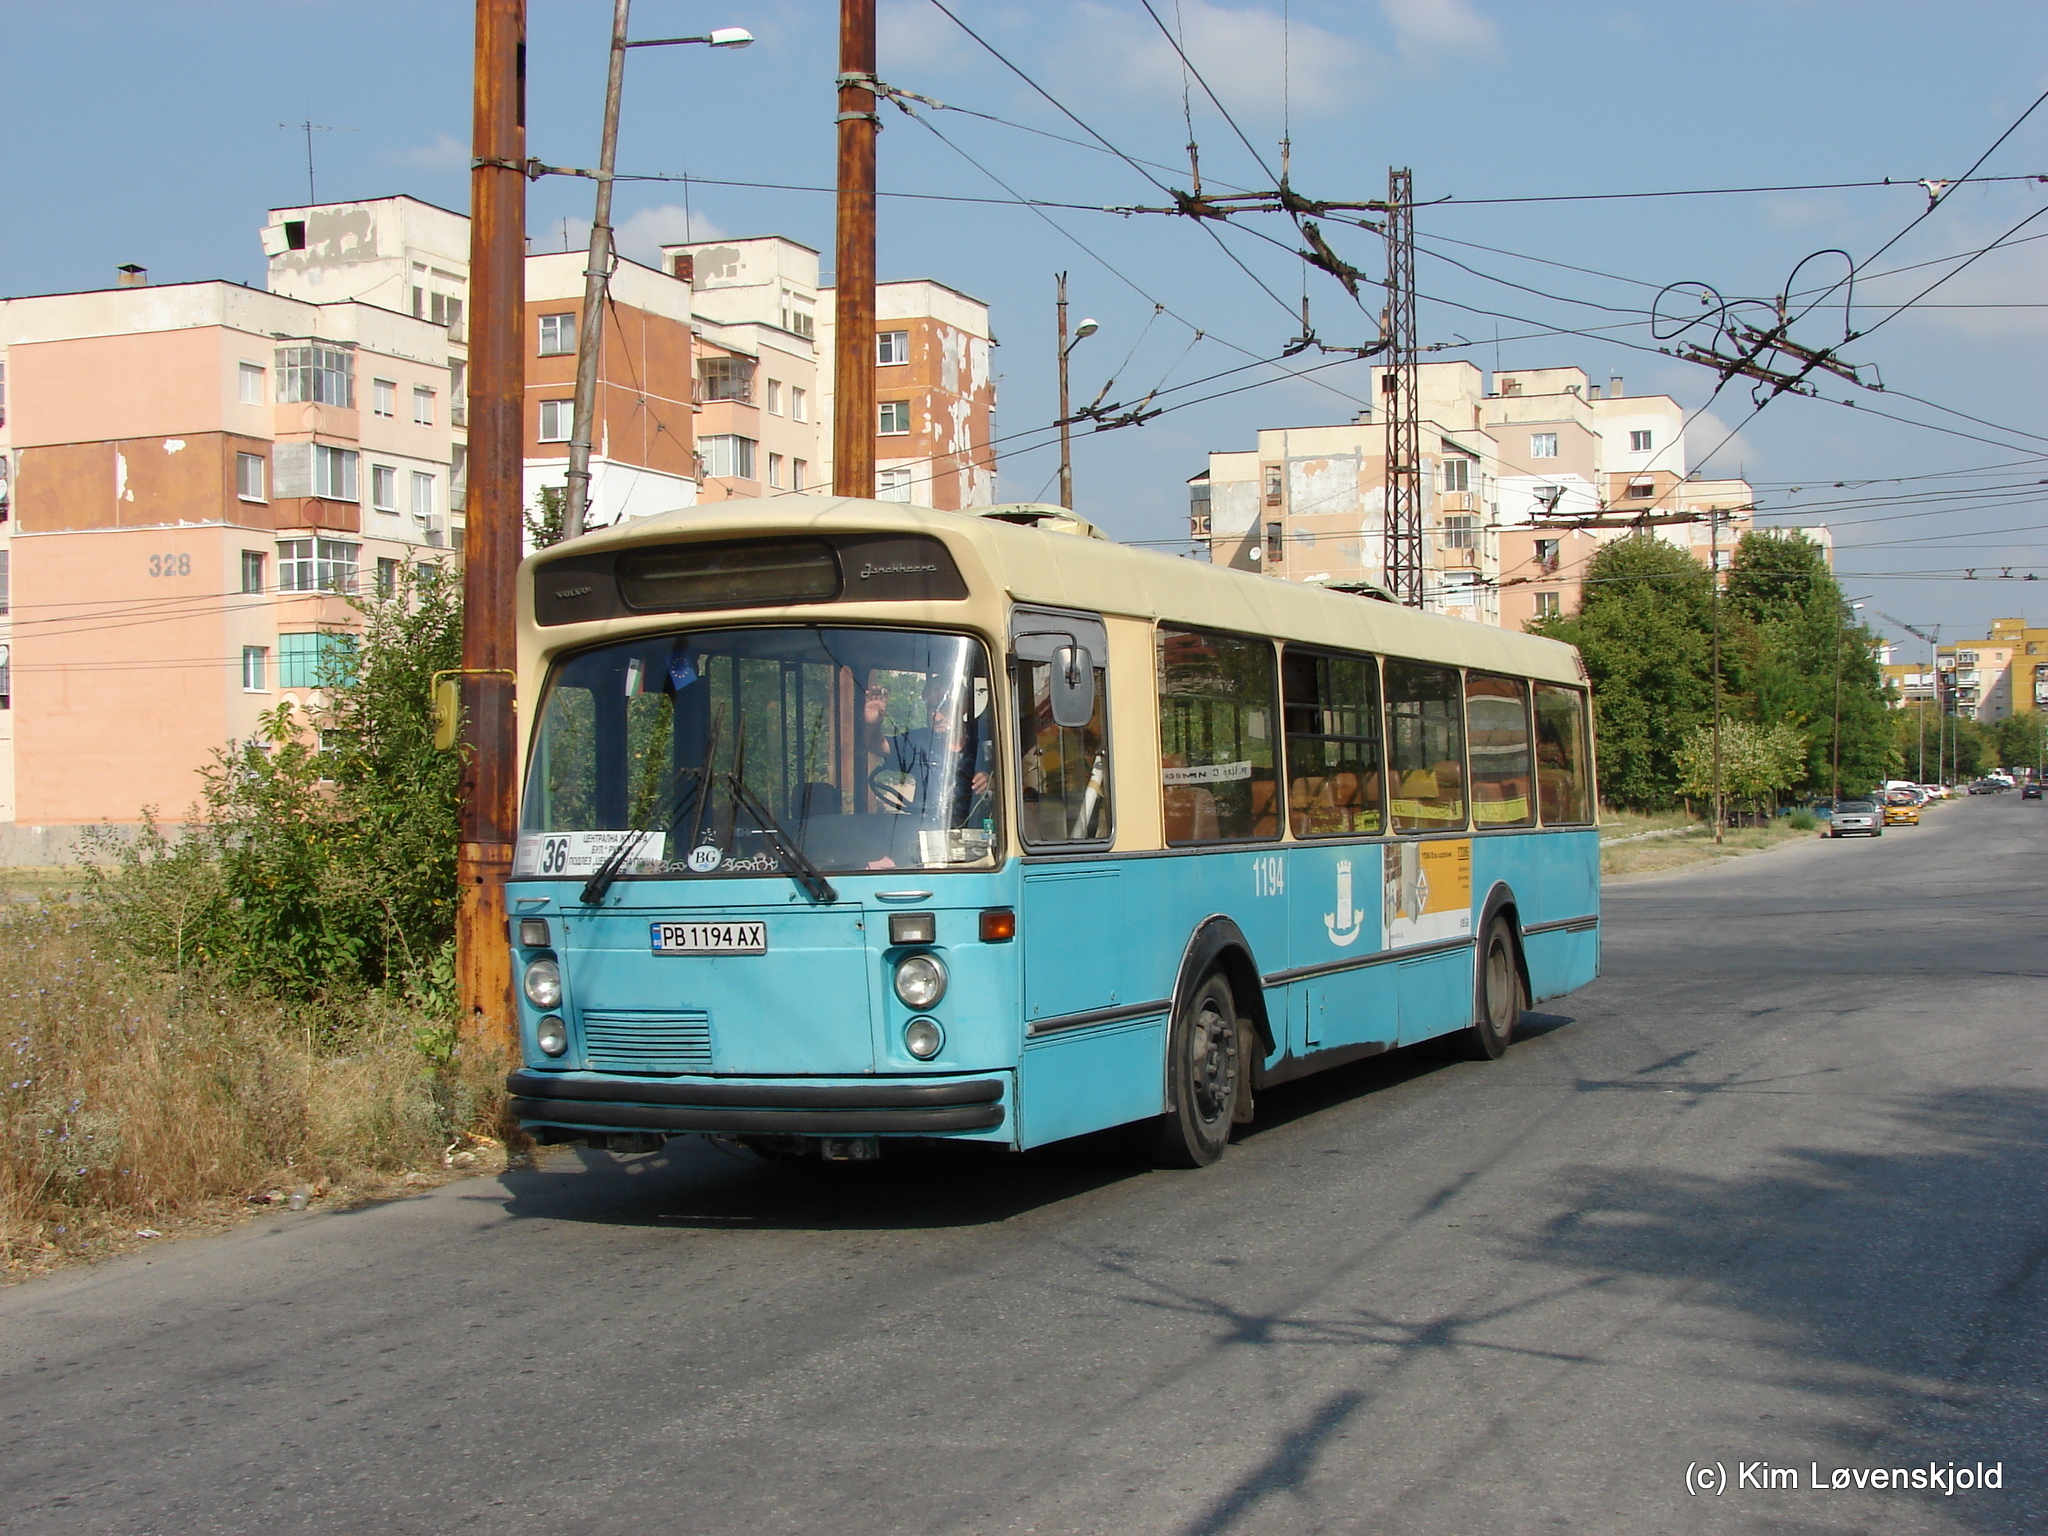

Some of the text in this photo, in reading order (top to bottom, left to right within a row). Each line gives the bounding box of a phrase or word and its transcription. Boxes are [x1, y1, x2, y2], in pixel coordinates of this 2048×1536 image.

[149, 553, 191, 577] 328
[556, 586, 591, 598] VOLVO
[543, 838, 568, 873] 36
[695, 850, 716, 864] BG
[1252, 856, 1284, 897] 1194
